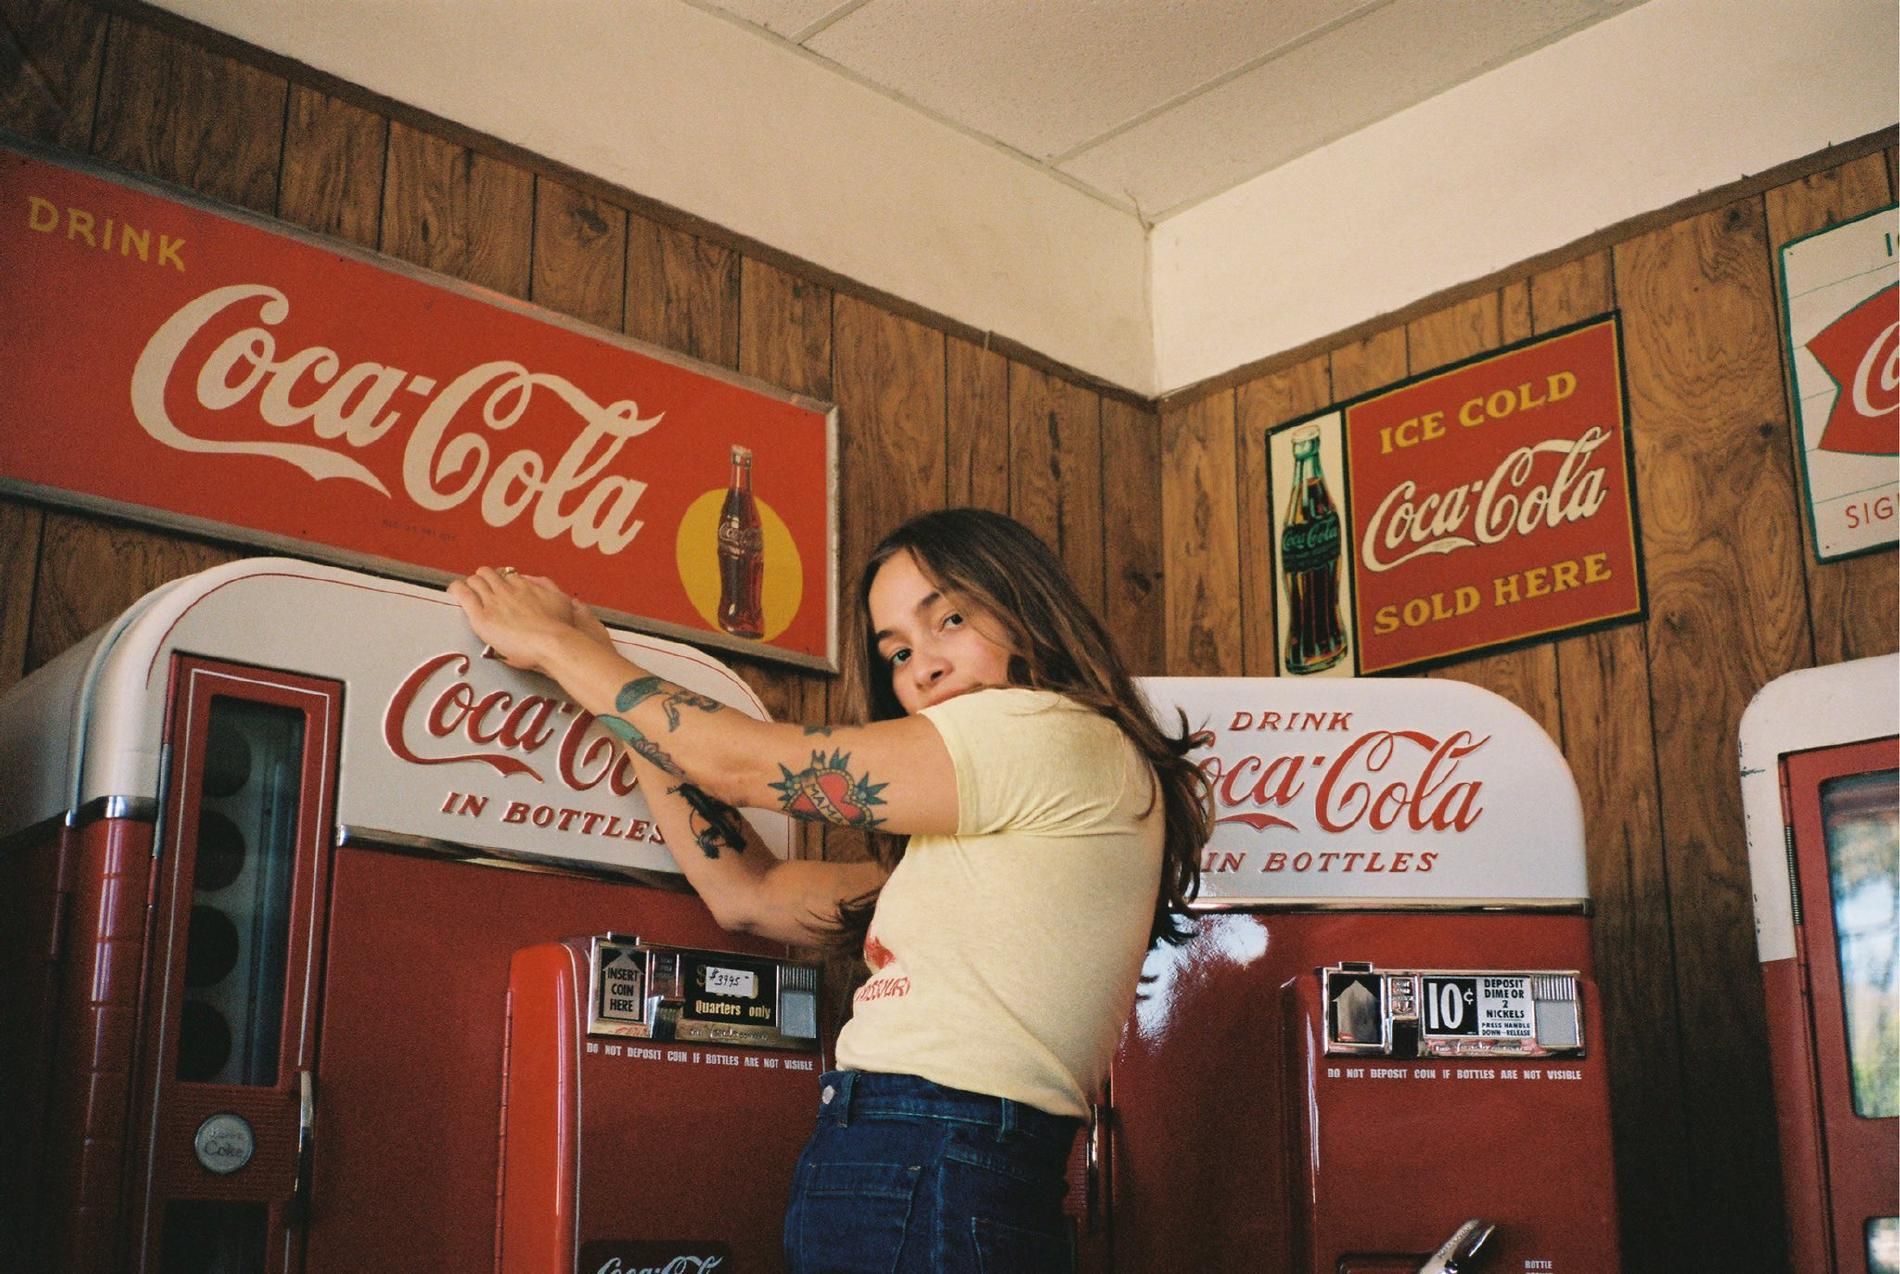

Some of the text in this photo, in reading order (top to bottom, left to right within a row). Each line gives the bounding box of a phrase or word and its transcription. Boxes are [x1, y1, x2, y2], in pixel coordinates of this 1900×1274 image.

[28, 196, 187, 272] DRINK
[131, 284, 665, 555] Coca-Cola
[1379, 371, 1577, 454] ICE COLD
[1361, 426, 1613, 573] Coca-Cola
[1845, 492, 1899, 529] SIG
[1373, 552, 1613, 635] SOLD HERE
[1229, 711, 1353, 732] DRINK
[1187, 730, 1491, 833] oca-Cola
[440, 792, 489, 817] IN
[1200, 852, 1439, 873] IN BOTTLES
[608, 967, 639, 981] INSERT
[1484, 979, 1523, 988] DEPOSIT
[612, 983, 634, 996] COIN
[1484, 989, 1524, 998] DIME OR
[610, 999, 634, 1012] HERE
[696, 999, 771, 1019] Quarters only
[1486, 1010, 1525, 1018] NICKELS
[1502, 1000, 1508, 1008] 2
[586, 1043, 813, 1071] DO NOT DEPOSIT COIN IF BOTTLES ARE NOT VISIBLE
[1327, 1068, 1582, 1080] DO NOT DEPOSIT COIN IF BOTTLES ARE NOT VISIBLE
[1525, 1260, 1553, 1269] BOTTLE
